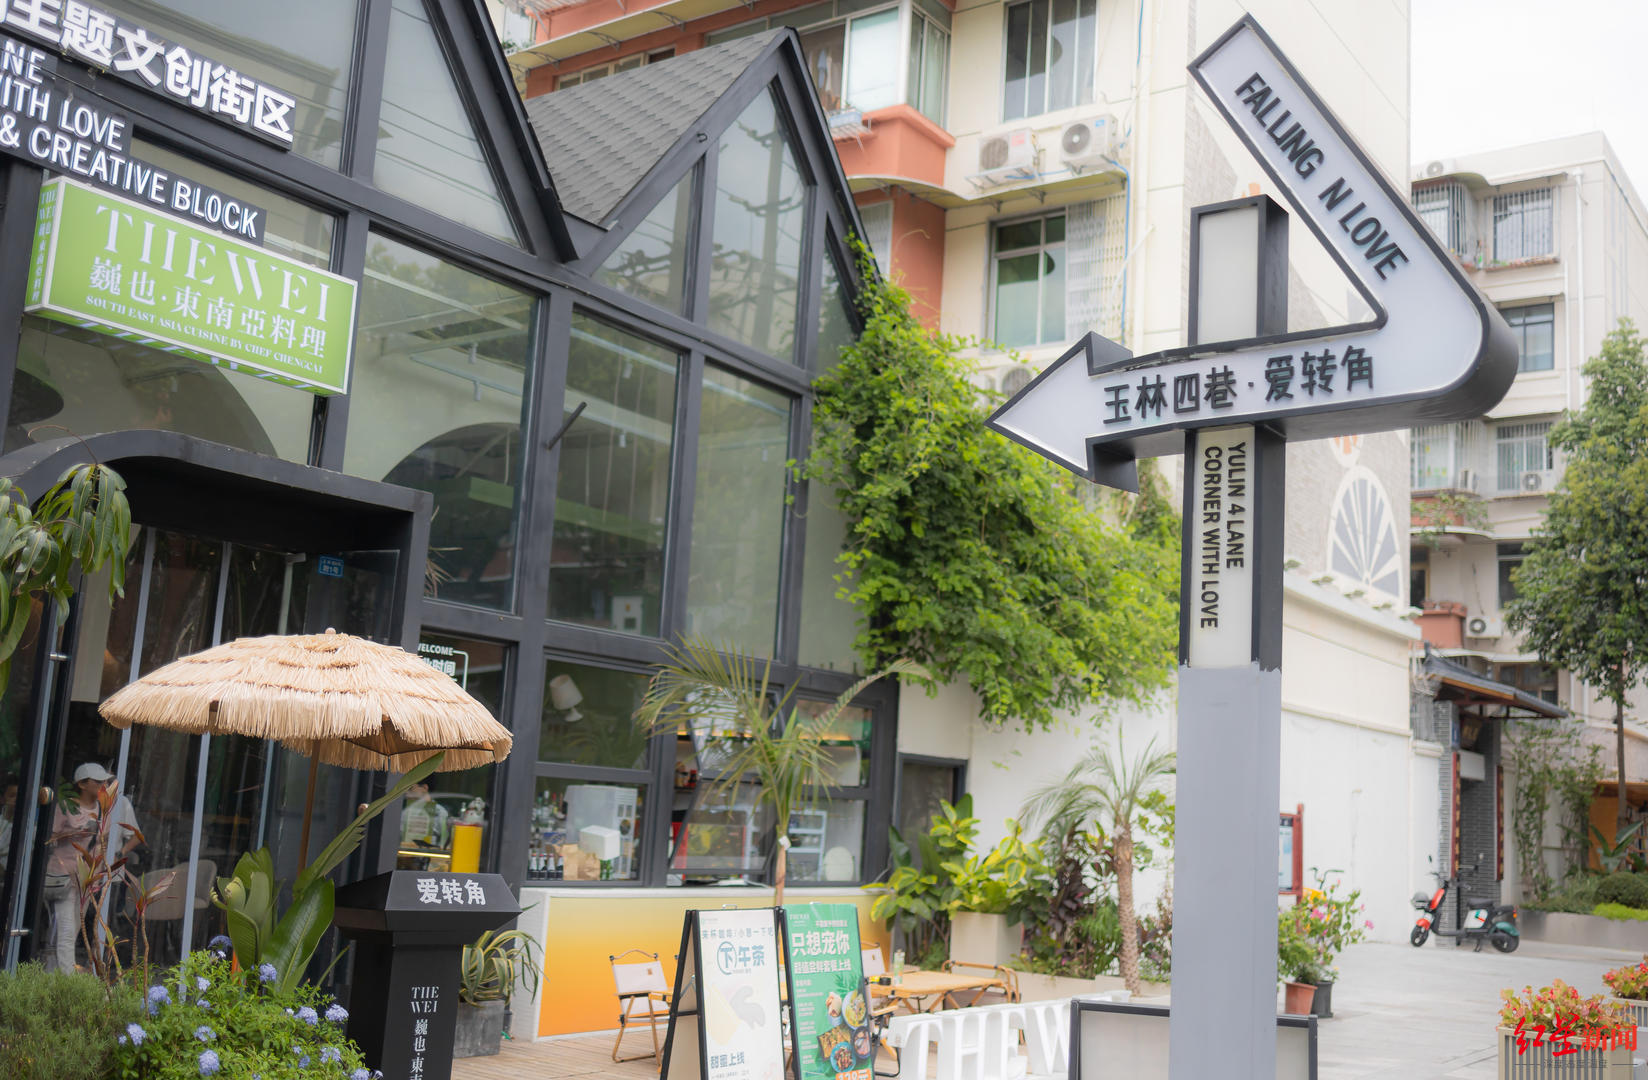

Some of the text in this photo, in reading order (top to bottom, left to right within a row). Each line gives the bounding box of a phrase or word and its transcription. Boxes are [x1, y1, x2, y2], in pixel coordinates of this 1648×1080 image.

[0, 0, 296, 143] 主题文创街区
[0, 72, 126, 152] ITH LOVE
[0, 111, 260, 239] & CREATIVE BLOCK
[1234, 71, 1411, 281] FALLING N LOVE
[86, 295, 126, 315] SOUTH
[128, 307, 156, 324] EAST
[158, 317, 182, 333] ASIA
[183, 324, 229, 347] CUISINE
[230, 338, 244, 351] BY
[245, 343, 273, 358] CHEF
[1102, 345, 1374, 425] 玉林四巷·爱转角
[1200, 446, 1223, 629] CORNER WITH LOVE
[1226, 441, 1246, 569] YULIN 4 LANE
[416, 878, 487, 906] 爱转角
[791, 930, 851, 957] 只想宠你
[411, 986, 440, 999] THE
[411, 1001, 438, 1013] WEI
